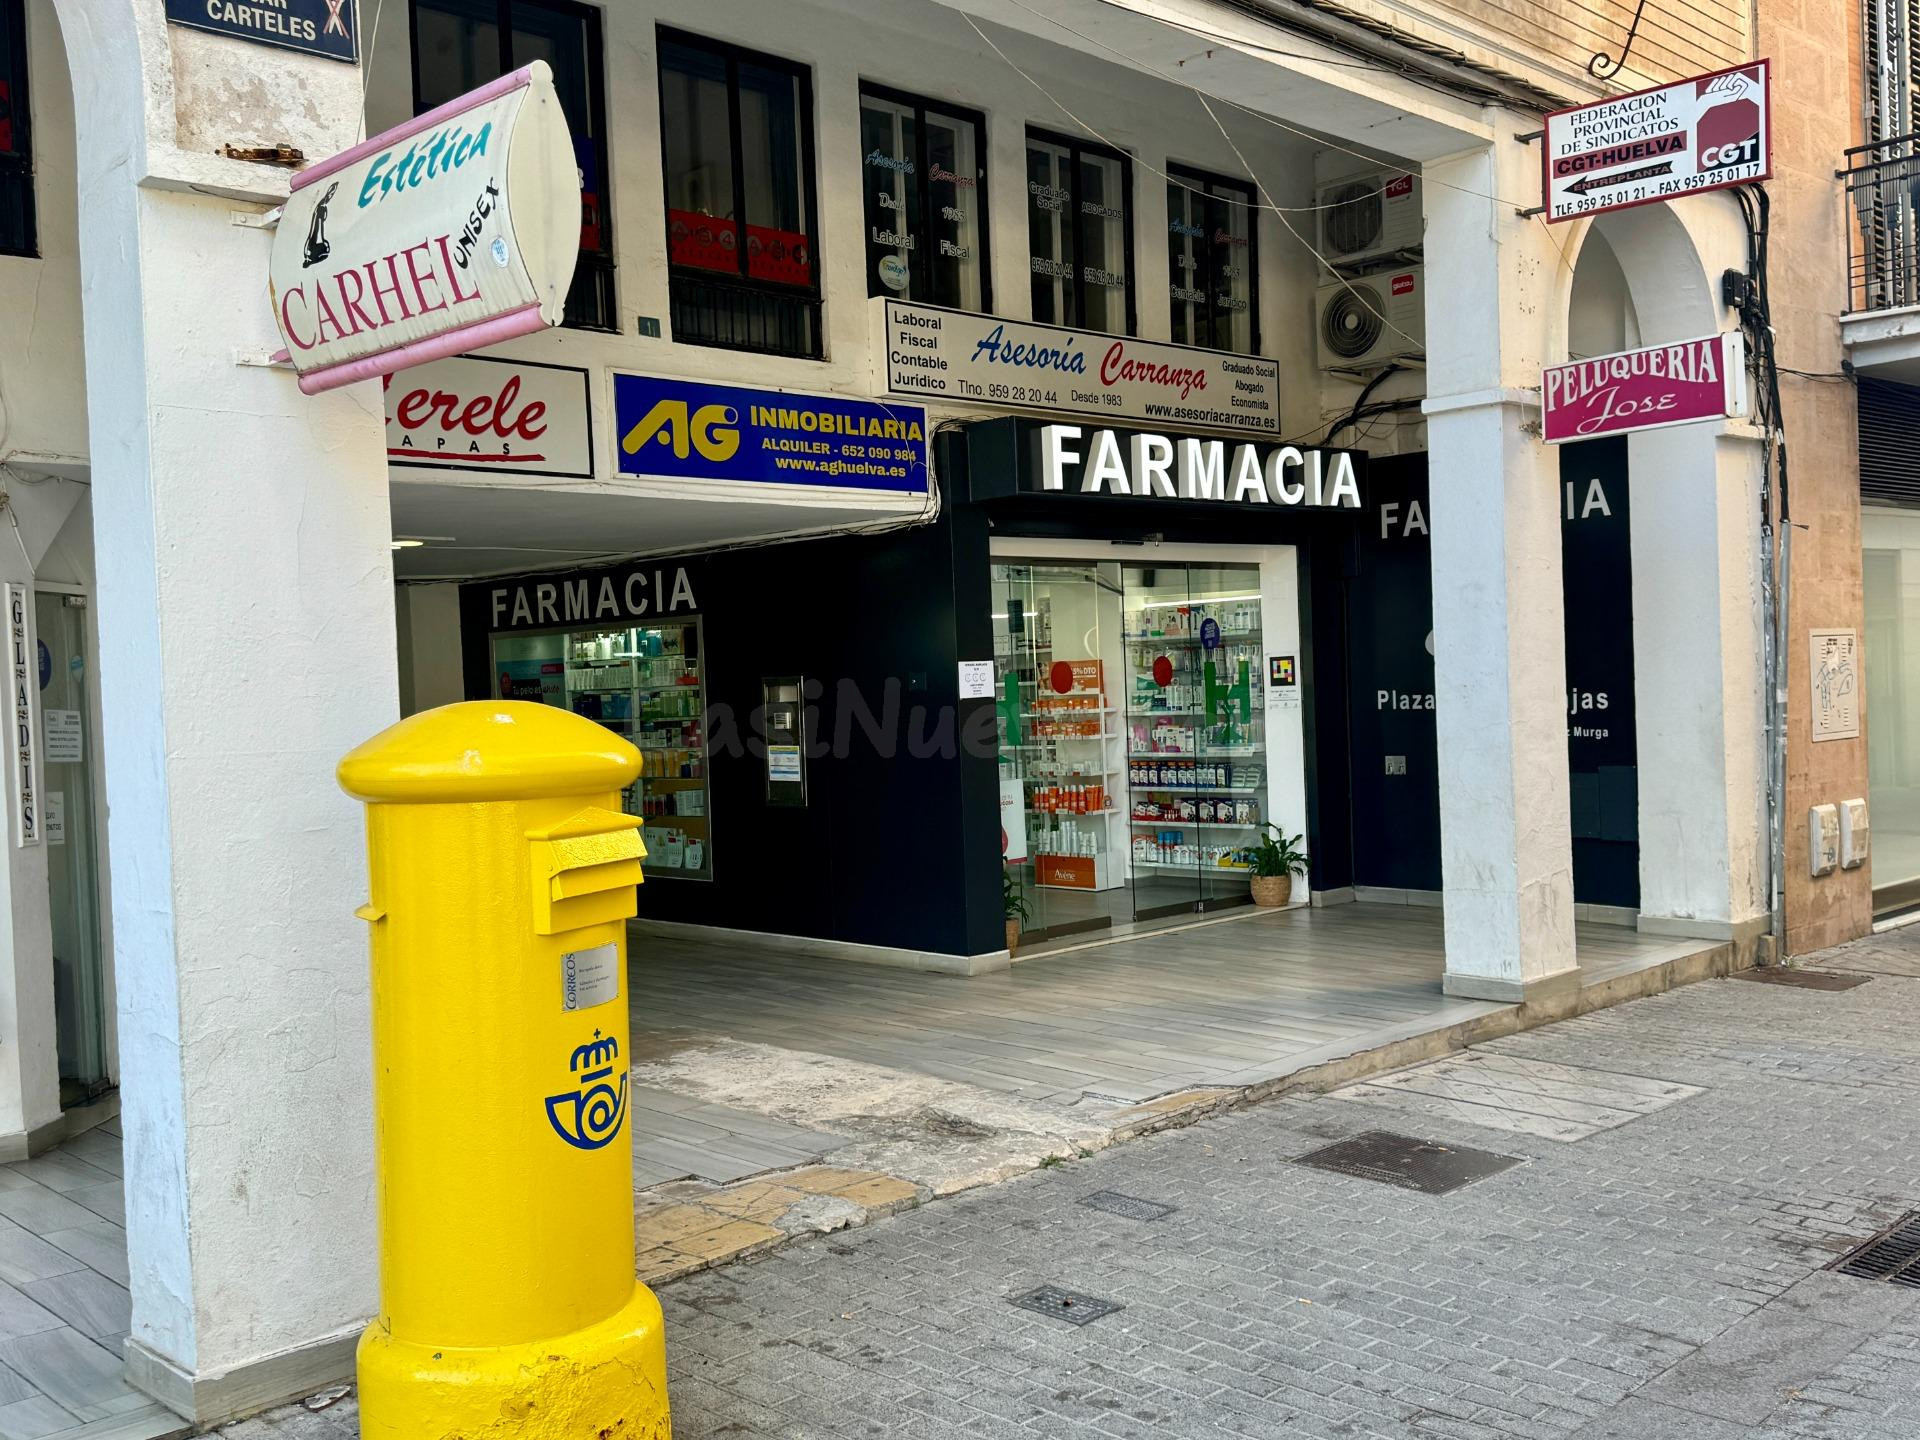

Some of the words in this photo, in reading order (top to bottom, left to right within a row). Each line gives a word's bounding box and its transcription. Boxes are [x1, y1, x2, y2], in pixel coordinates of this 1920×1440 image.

[207, 0, 316, 41] CARTELES
[1570, 92, 1667, 126] FEDERACION
[1573, 108, 1664, 138] PROVINCIAL
[1561, 140, 1581, 155] DE
[1586, 118, 1678, 147] SINDICATOS
[357, 122, 492, 208] Estética
[1557, 135, 1683, 175] CGT-HUELVA
[1701, 138, 1756, 168] CGT
[1029, 181, 1070, 201] Graduado
[1555, 203, 1574, 216] TLF.
[1577, 197, 1596, 212] 959
[1600, 194, 1612, 207] 25
[1617, 191, 1629, 203] 01
[1633, 187, 1645, 200] 21
[1659, 180, 1680, 193] FAX
[1684, 173, 1705, 188] 959
[1709, 169, 1722, 183] 25
[1727, 167, 1740, 180] 01
[1747, 163, 1760, 176] 17
[1573, 164, 1671, 192] ENTREPLANTA
[1036, 196, 1063, 213] Social
[1081, 201, 1122, 219] ABOGADOS
[453, 177, 501, 269] UNISEX
[873, 227, 914, 249] Laboral
[940, 240, 969, 259] Fiscal
[282, 234, 483, 350] CARHEL
[894, 311, 942, 330] Laboral
[900, 332, 937, 349] Fiscal
[891, 351, 948, 371] Contable
[971, 324, 1086, 375] Asesoría
[1100, 341, 1208, 400] Carranza
[1222, 360, 1253, 376] Graduado
[1255, 363, 1276, 378] Social
[1547, 340, 1718, 411] PELUQUERIA
[894, 370, 946, 390] Jurídico
[988, 382, 1009, 399] 959
[1012, 385, 1025, 401] 28
[1028, 386, 1041, 402] 20
[1044, 389, 1057, 404] 44
[1071, 389, 1099, 405] Desde
[1101, 393, 1122, 407] 1983
[1235, 379, 1264, 394] Abogado
[383, 373, 548, 441] erele
[1145, 403, 1276, 429] www.asesoriacarranza.es
[1231, 395, 1269, 411] Economista
[622, 399, 740, 462] AG
[750, 405, 923, 441] INMOBILIARIA
[402, 435, 510, 455] APAS
[762, 438, 831, 455] ALQUILER
[842, 445, 865, 458] 652
[869, 447, 890, 459] 090
[894, 449, 916, 461] 984
[775, 457, 906, 477] www.aghuelva.es
[1041, 424, 1361, 508] FARMACIA
[491, 567, 697, 628] FARMACIA
[1377, 689, 1435, 710] Plaza
[1570, 687, 1609, 714] jas
[12, 600, 33, 830] GLADIS
[1573, 726, 1609, 740] Murga
[565, 953, 575, 1010] CORREOS
